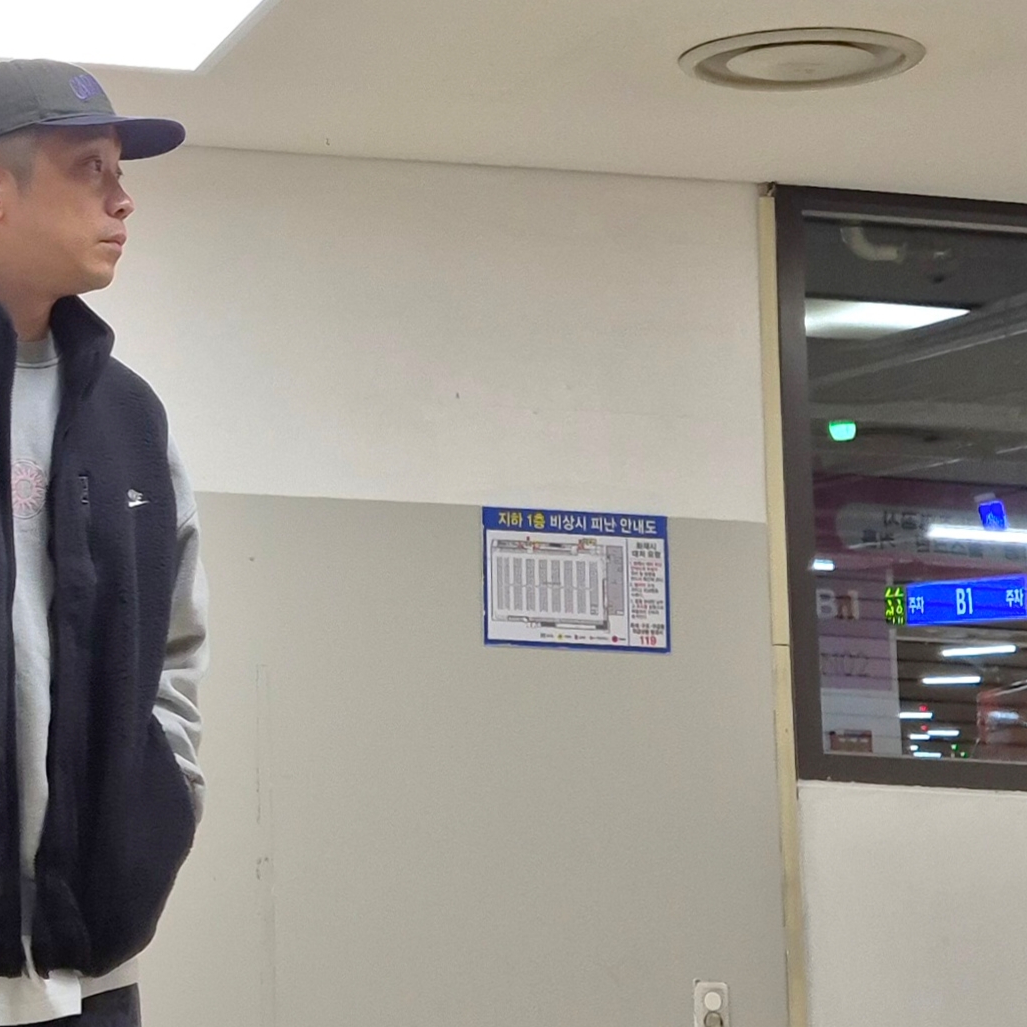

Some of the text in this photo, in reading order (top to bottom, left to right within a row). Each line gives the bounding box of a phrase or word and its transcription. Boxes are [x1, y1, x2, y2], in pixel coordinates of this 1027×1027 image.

[498, 512, 657, 534] 지하 1층 비상시 피난 안내도
[956, 587, 973, 615] B1
[639, 636, 657, 645] 119
